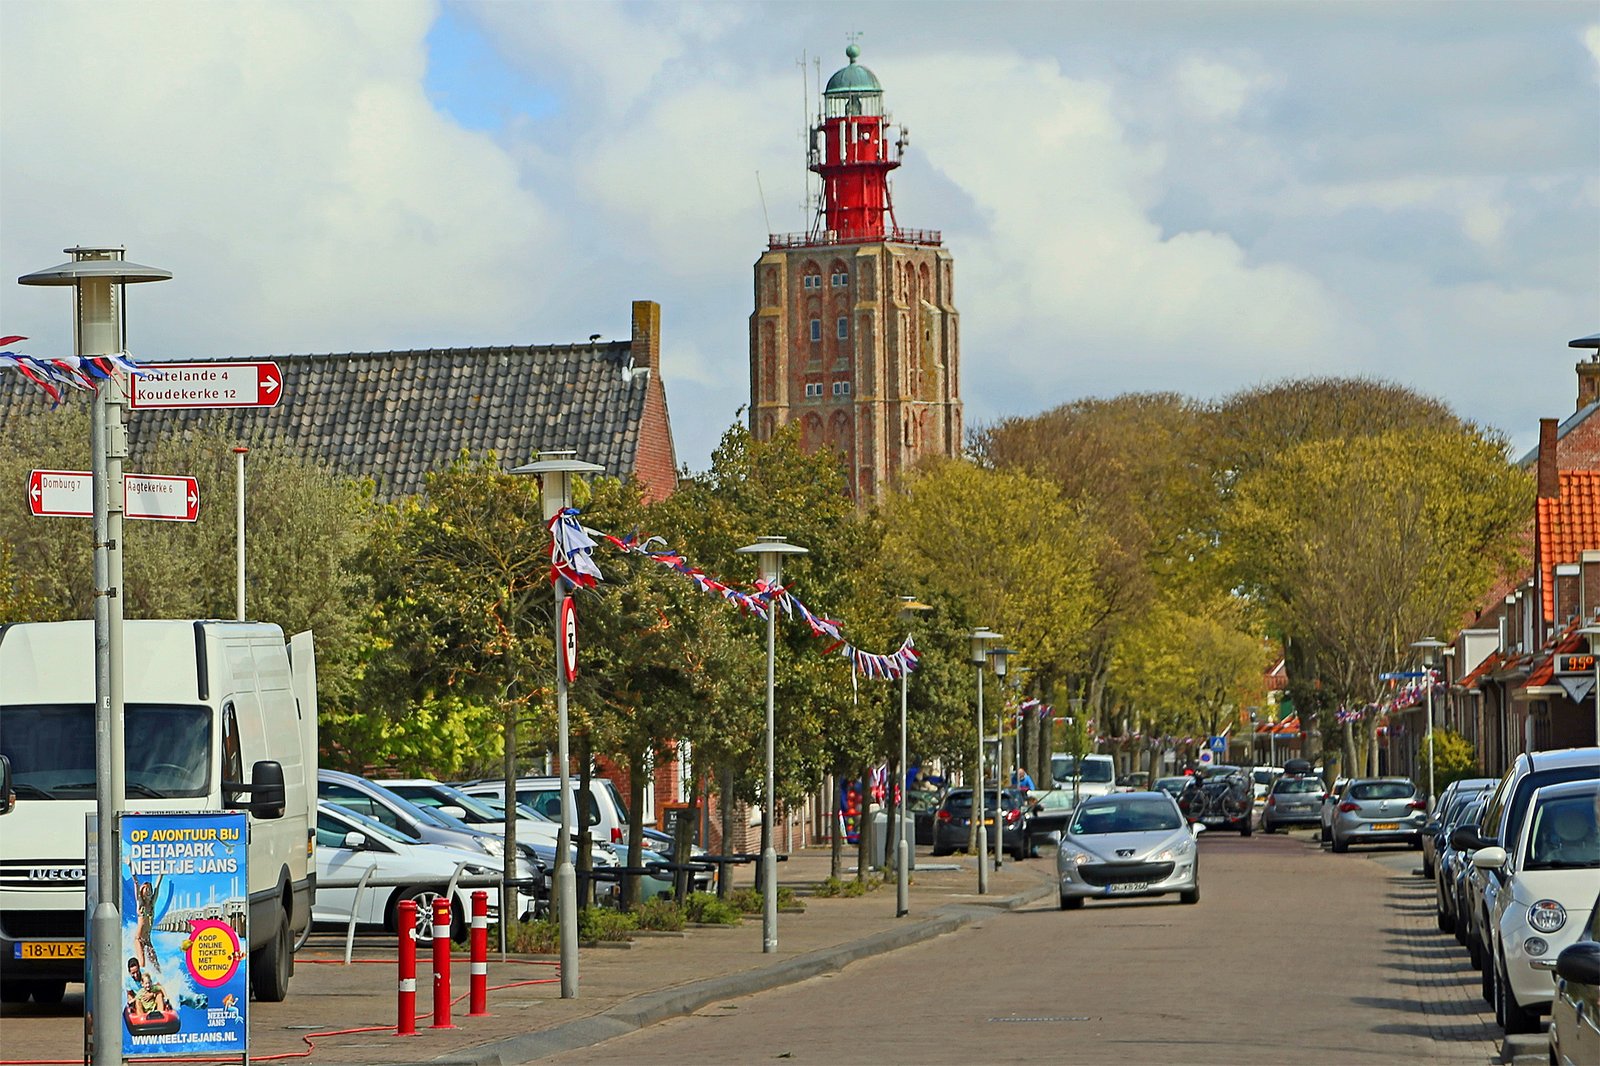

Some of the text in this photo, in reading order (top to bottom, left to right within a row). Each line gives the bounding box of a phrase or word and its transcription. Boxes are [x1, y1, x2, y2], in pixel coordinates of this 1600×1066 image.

[221, 371, 229, 380] 4
[138, 388, 236, 400] Koudekerke 12
[43, 477, 81, 492] Domburg 7
[128, 481, 174, 494] Aagtekerke 6
[131, 828, 239, 842] OP AVONTUUR BIJ
[131, 843, 215, 859] DELTAPARK
[131, 858, 238, 876] NEELTJE JANS
[29, 868, 83, 880] IVECO
[207, 1019, 226, 1027] JANS
[132, 1032, 237, 1045] WWW.NEELTJEJANS.NL
